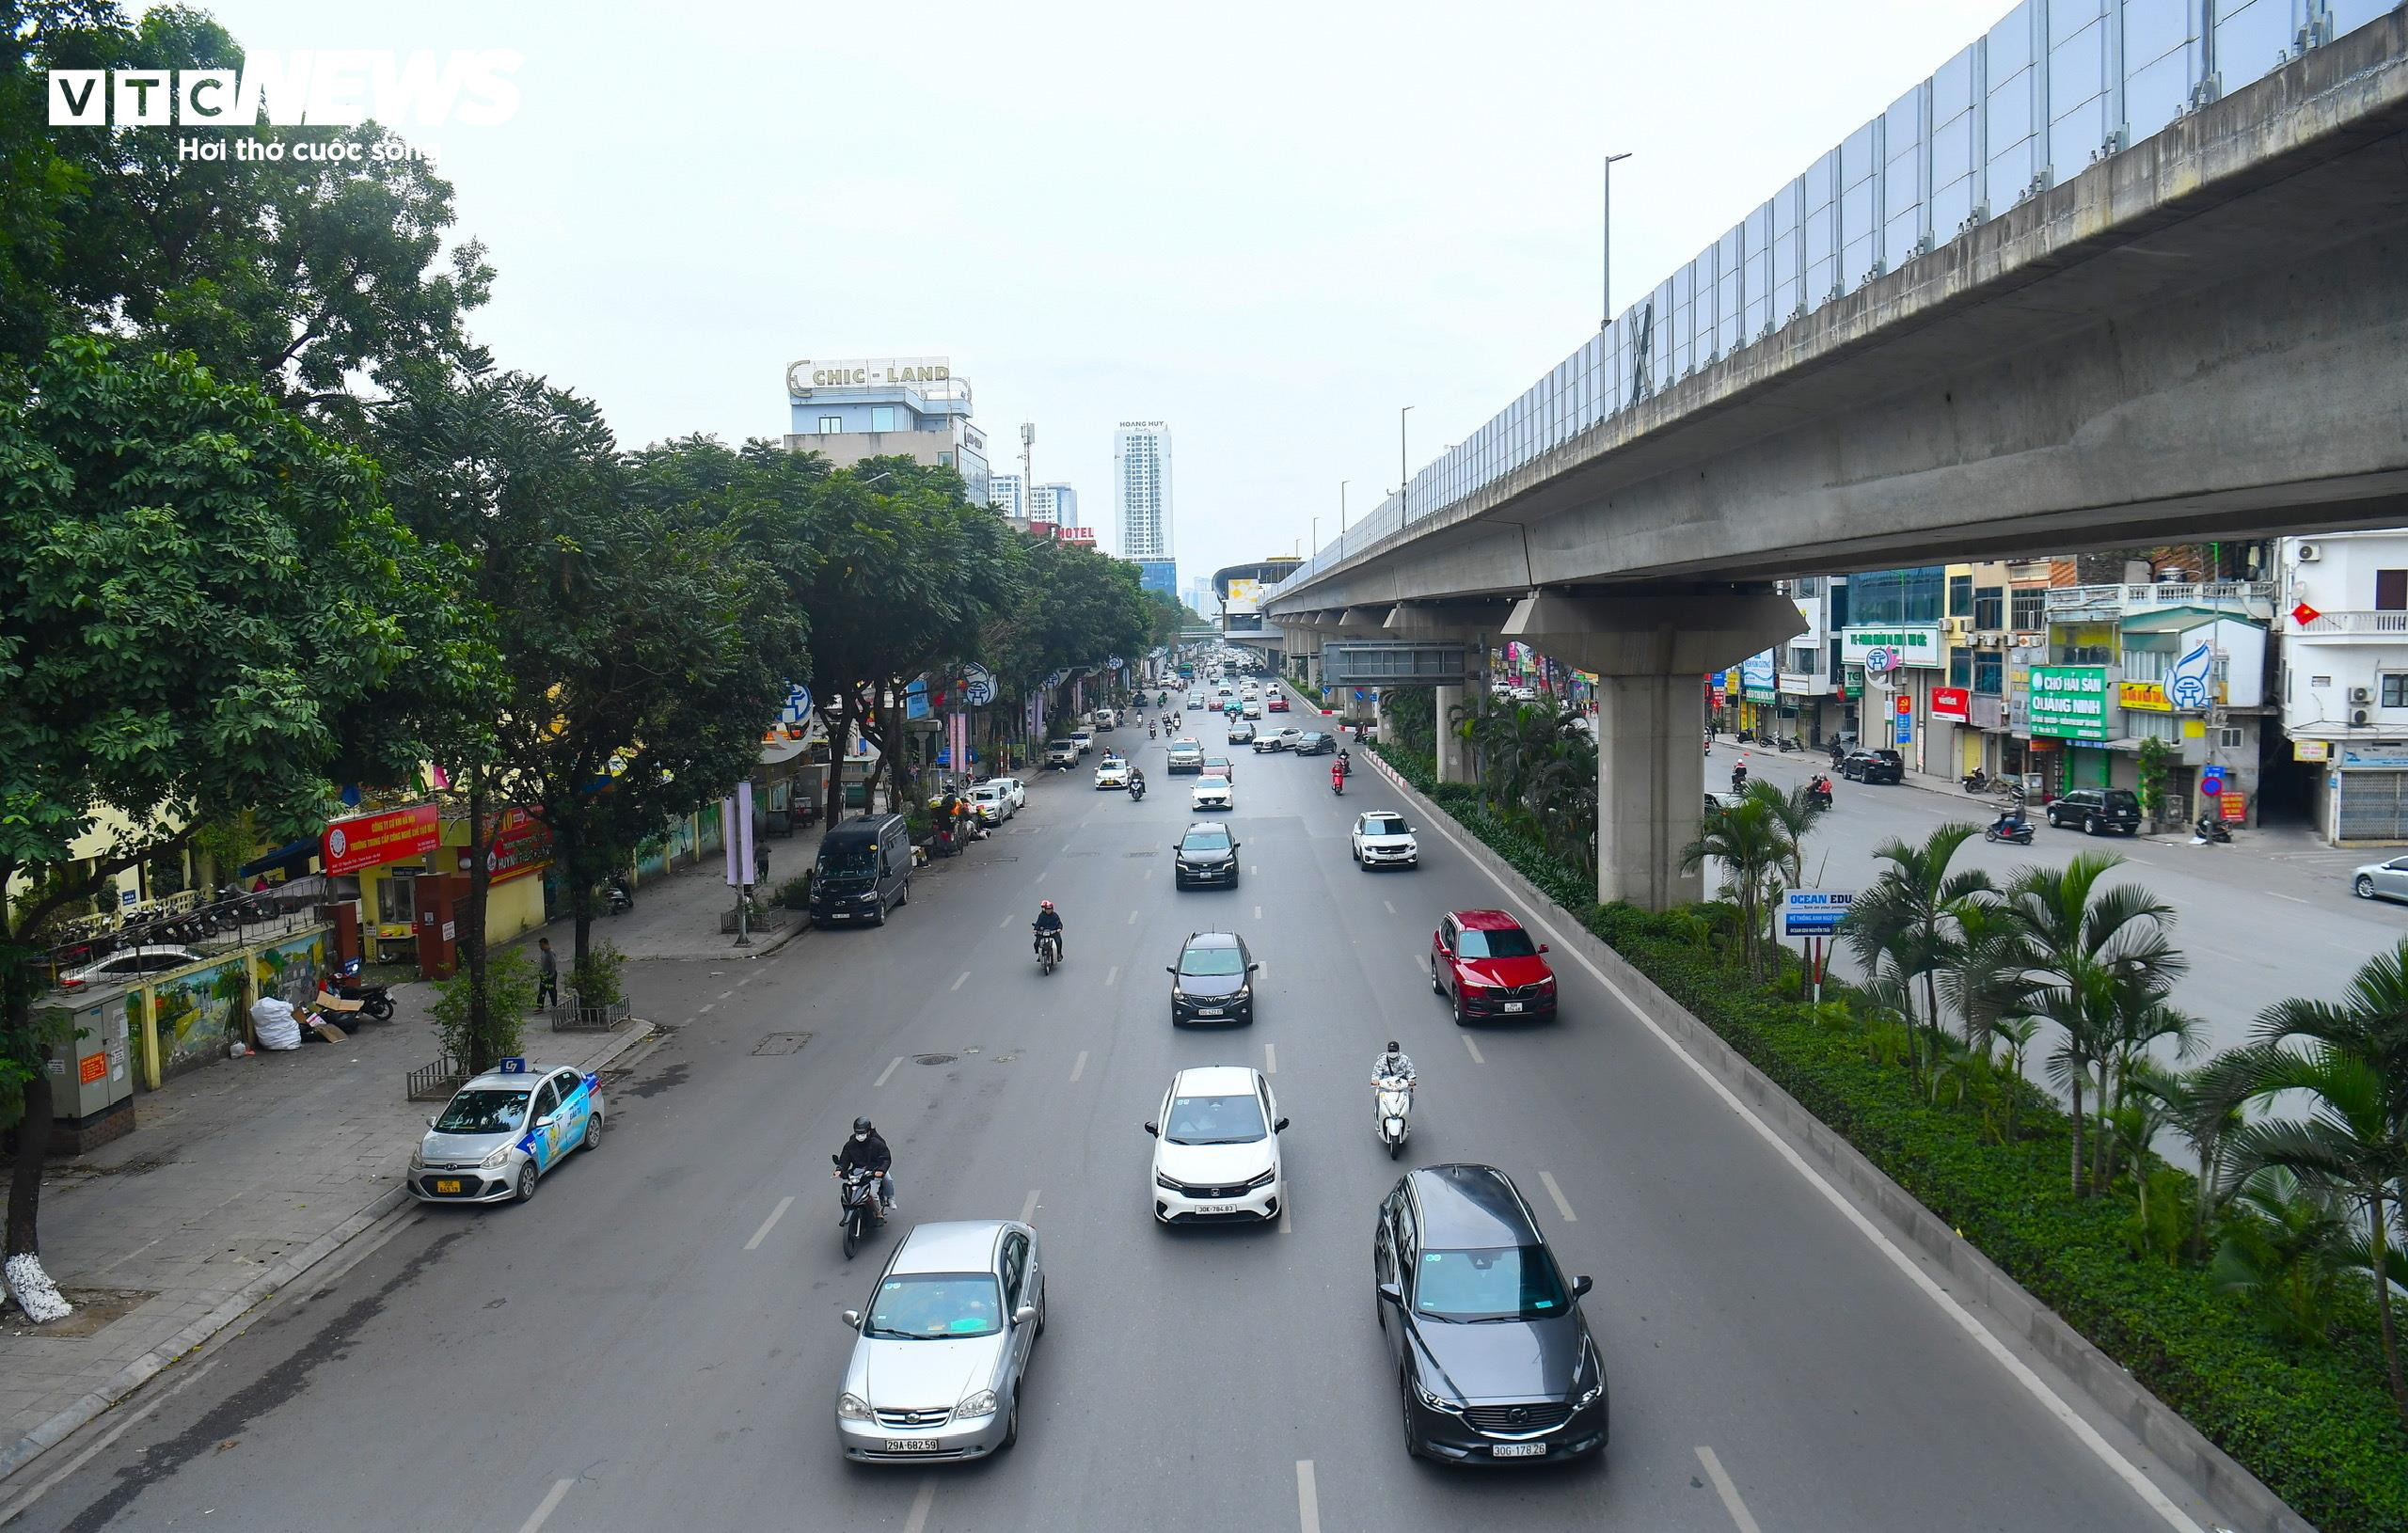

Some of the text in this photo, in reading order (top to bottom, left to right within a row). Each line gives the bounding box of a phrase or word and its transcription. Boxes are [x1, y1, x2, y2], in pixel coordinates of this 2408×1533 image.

[812, 369, 866, 386] CHIC
[887, 366, 949, 383] LAND
[1058, 527, 1095, 540] HOTEL
[2064, 672, 2080, 692] HẢI
[2082, 672, 2101, 693] SẢN
[2033, 693, 2101, 715] QUẢNG NINH
[1790, 894, 1852, 904] OCEAN EDU
